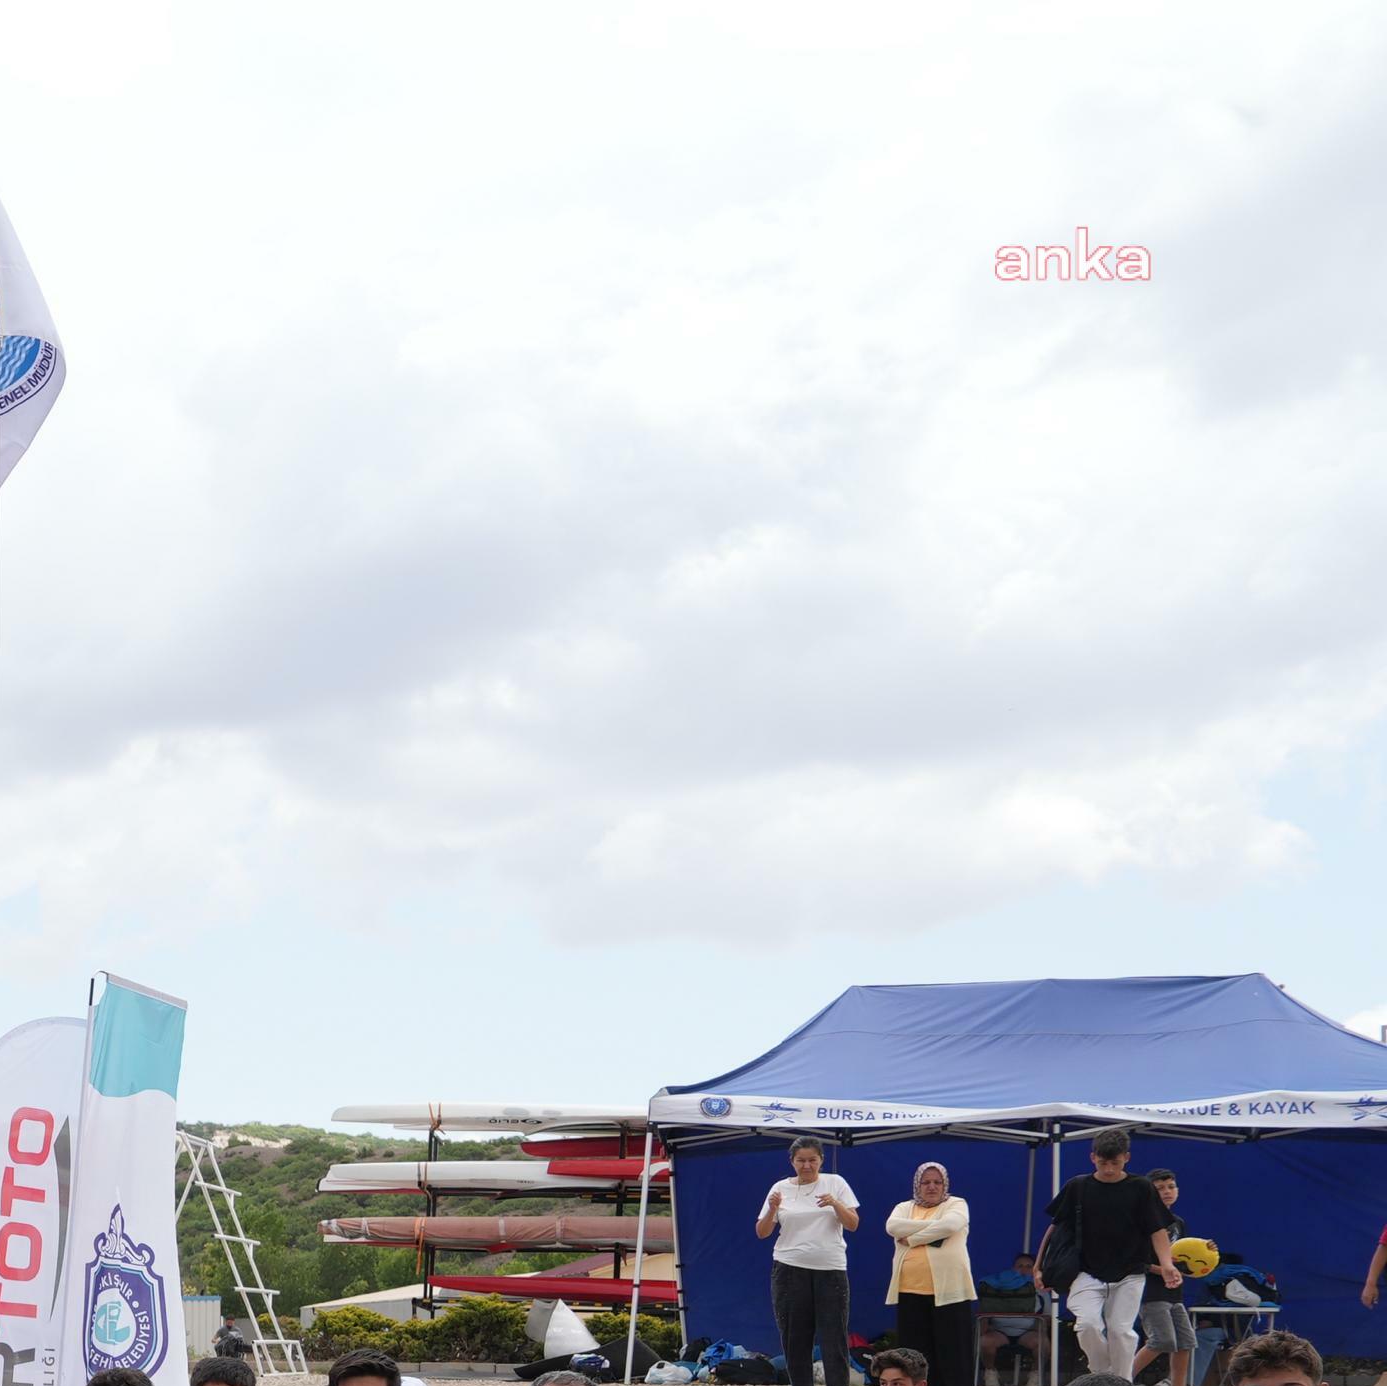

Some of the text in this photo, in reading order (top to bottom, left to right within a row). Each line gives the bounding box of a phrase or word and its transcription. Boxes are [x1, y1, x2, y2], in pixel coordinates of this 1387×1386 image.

[816, 1107, 876, 1121] BURSA
[1228, 1103, 1241, 1116] &
[1249, 1100, 1316, 1115] KAYAK
